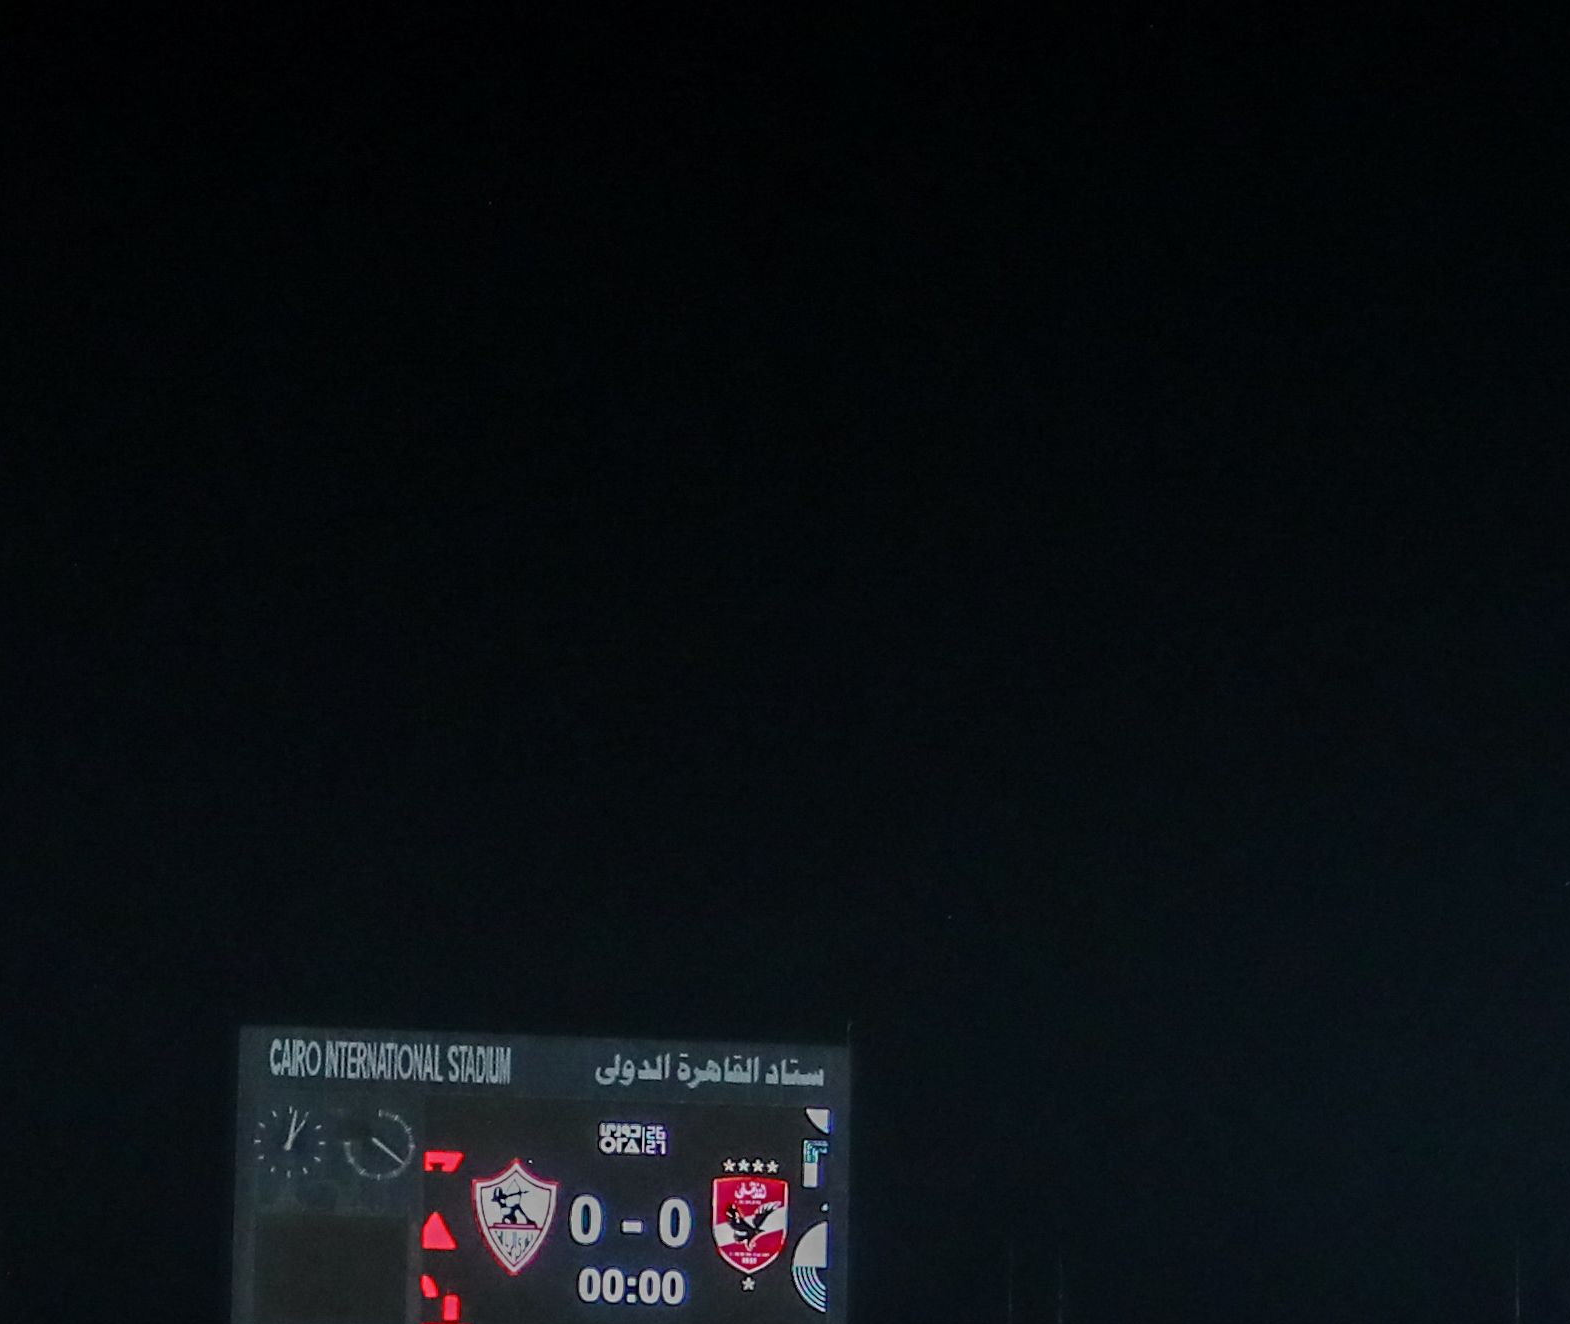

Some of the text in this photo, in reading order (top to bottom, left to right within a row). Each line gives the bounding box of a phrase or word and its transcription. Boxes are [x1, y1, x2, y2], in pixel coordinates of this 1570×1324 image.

[269, 1038, 512, 1085] CAIRO INTERNATIONAL STADIUM
[676, 1053, 760, 1089] القاهرة
[765, 1058, 825, 1087] ستاد
[570, 1194, 603, 1246] 0
[658, 1197, 692, 1249] 0
[577, 1267, 686, 1305] 00:00
